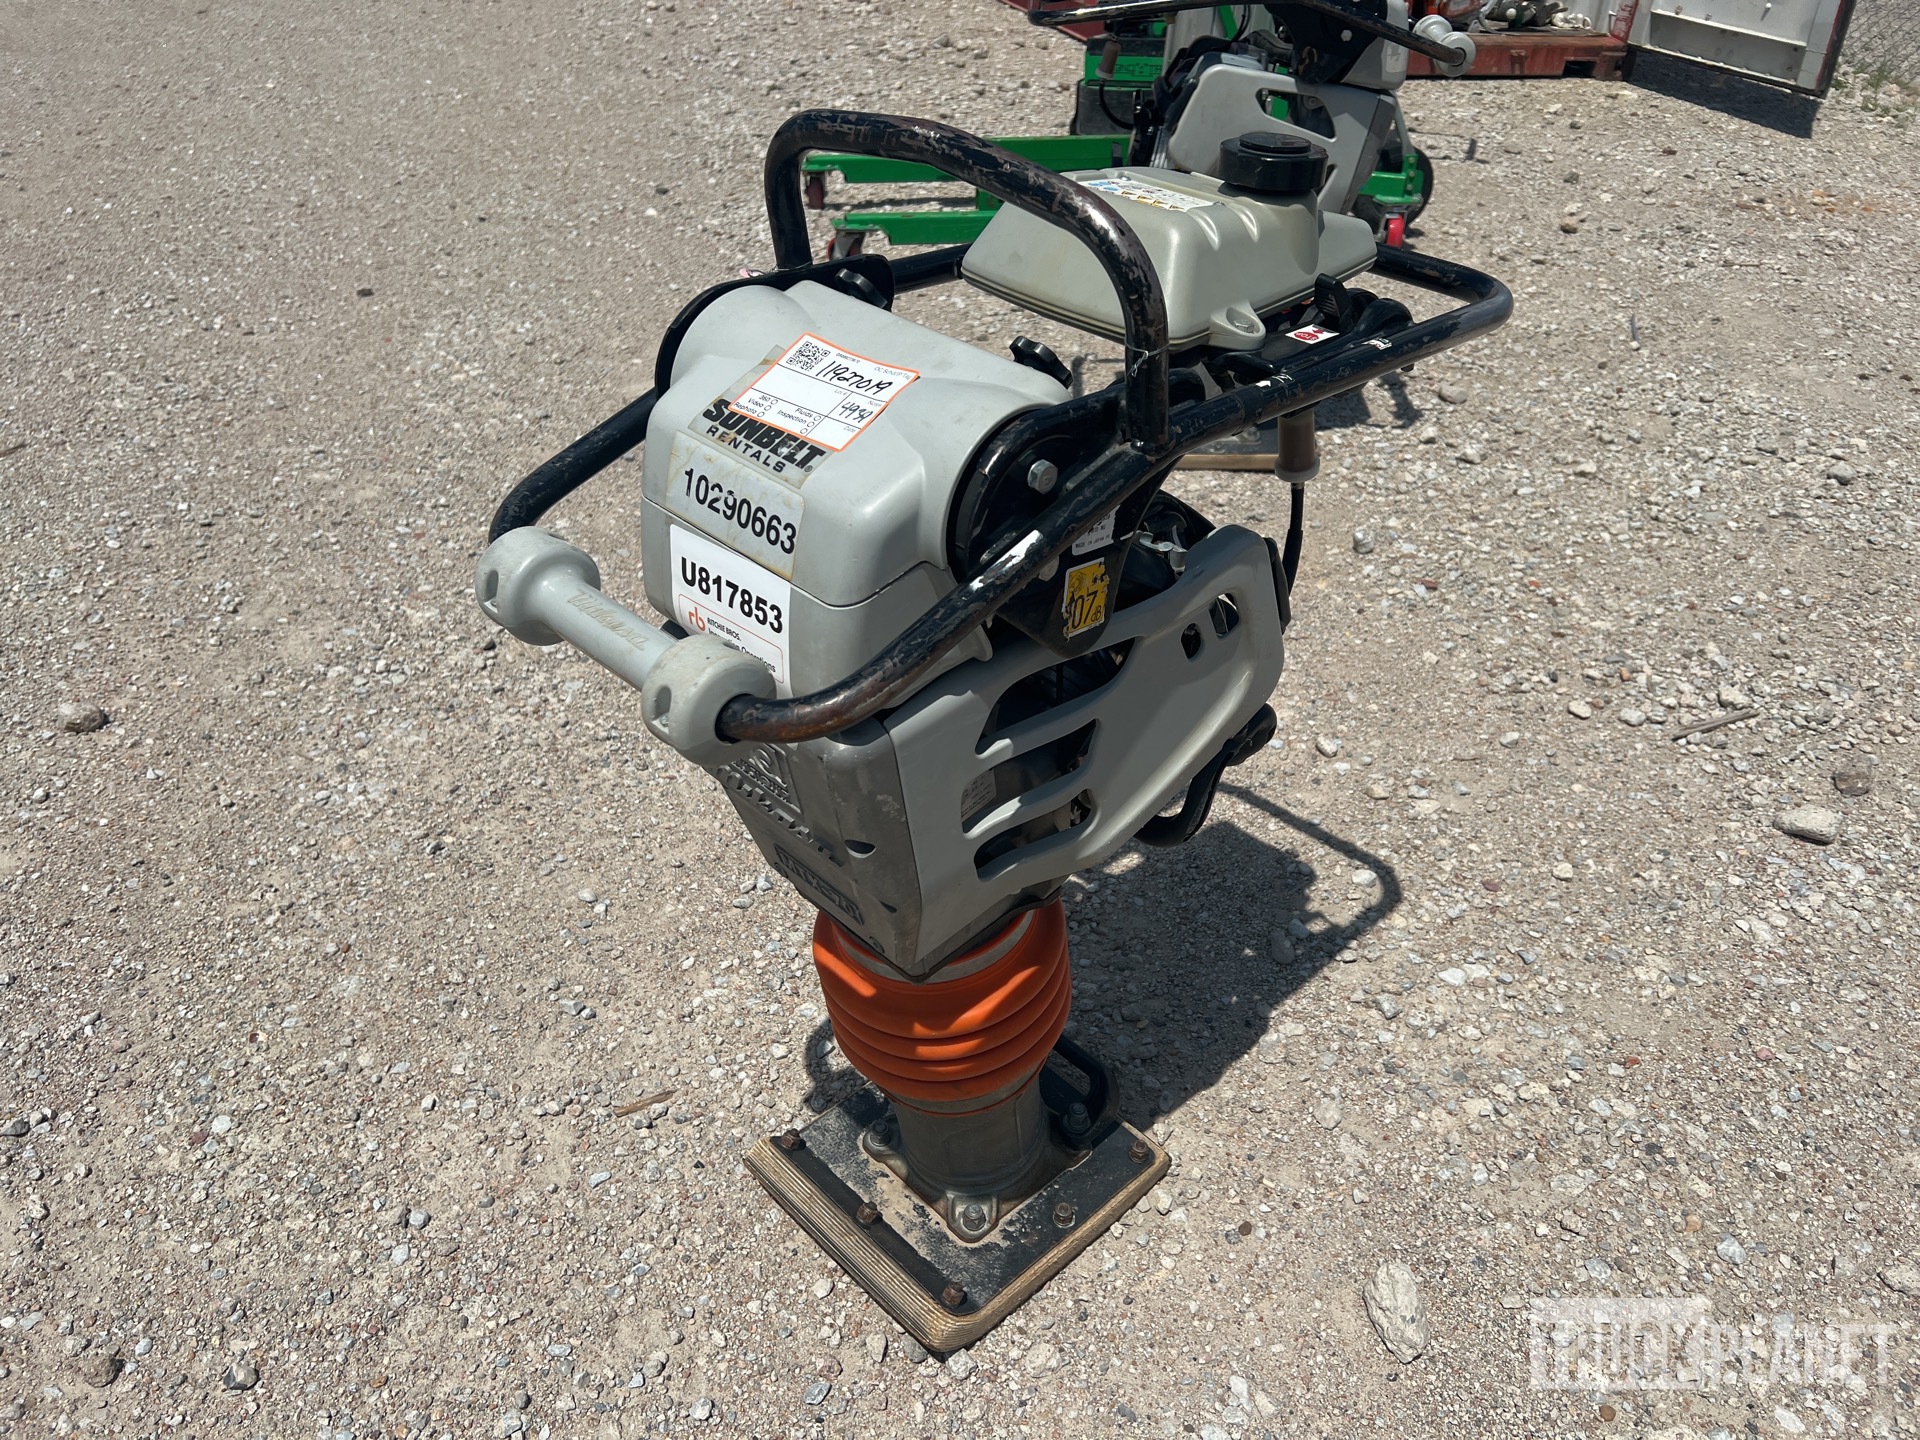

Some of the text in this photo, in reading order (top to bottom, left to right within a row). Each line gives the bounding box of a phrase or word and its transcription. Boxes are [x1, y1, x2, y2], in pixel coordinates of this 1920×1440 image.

[815, 360, 893, 395] 11927019
[748, 397, 764, 408] Video
[794, 407, 814, 419] Fluids
[776, 409, 808, 425] Inspection
[706, 425, 786, 473] RENTALS
[684, 467, 797, 555] 10290663
[681, 556, 783, 634] U817853
[1066, 586, 1099, 629] 07
[688, 606, 706, 632] rb
[707, 617, 726, 633] RITCHIE
[1090, 604, 1102, 623] dB
